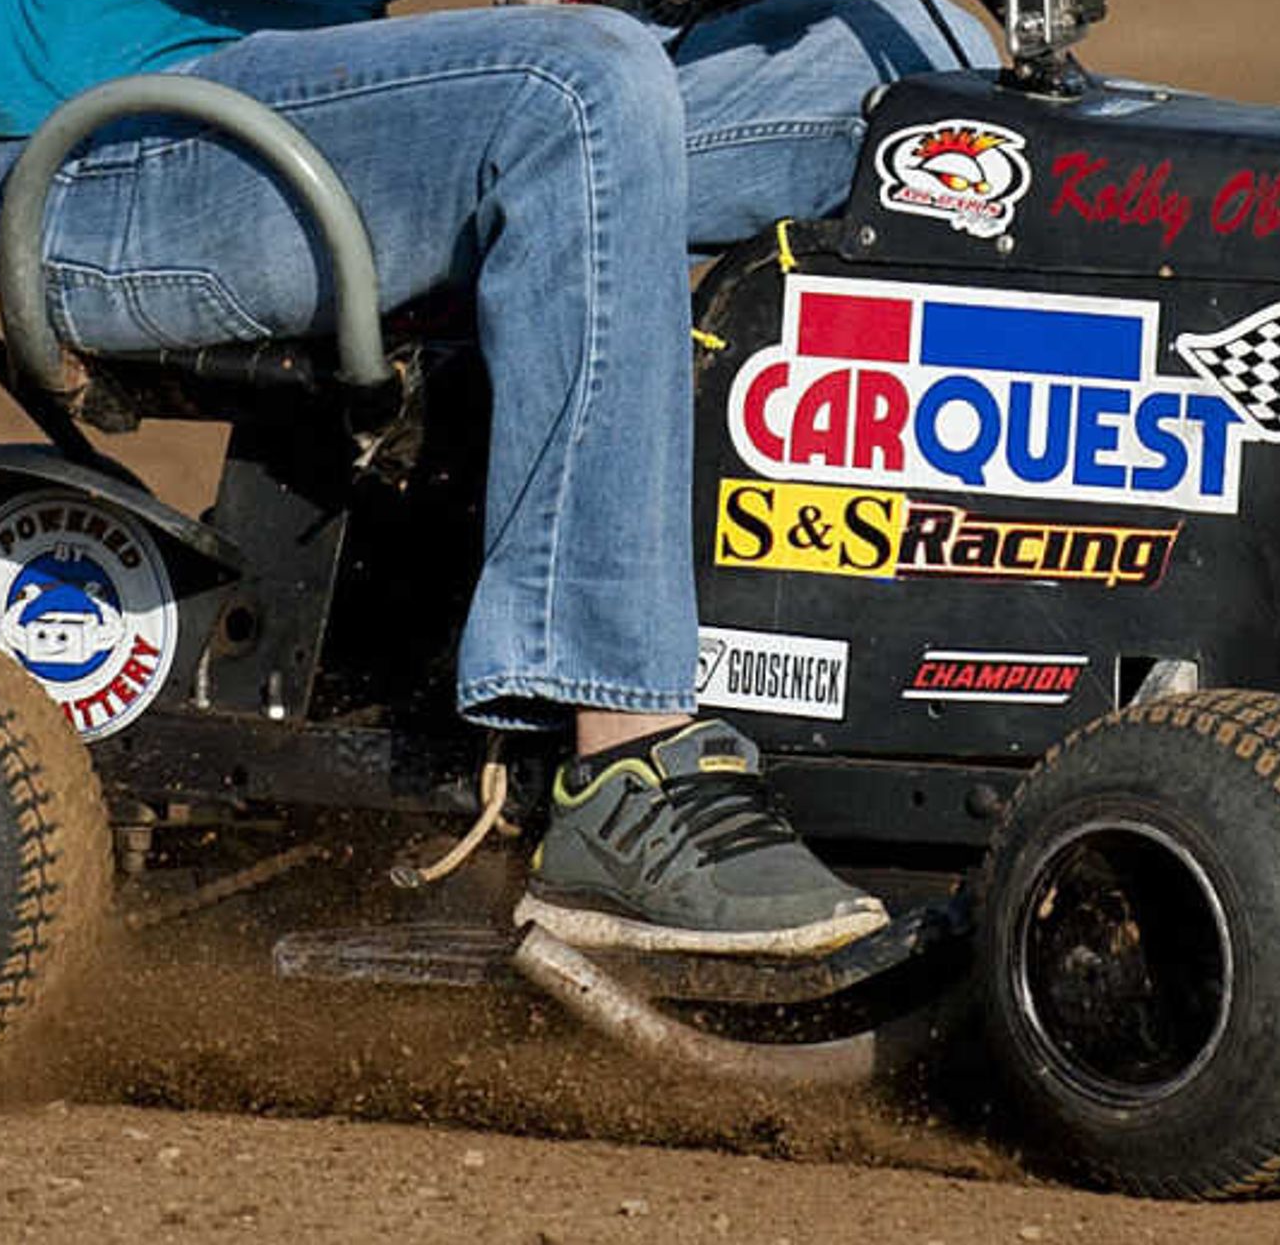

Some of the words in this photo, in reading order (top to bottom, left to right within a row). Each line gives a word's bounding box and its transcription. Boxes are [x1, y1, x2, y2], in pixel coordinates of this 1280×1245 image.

[1051, 152, 1192, 246] Kolby
[743, 362, 1242, 496] CARQUEST
[901, 509, 1172, 584] Racing
[727, 649, 841, 705] GOOSENECK
[913, 663, 1080, 690] CHAMPION
